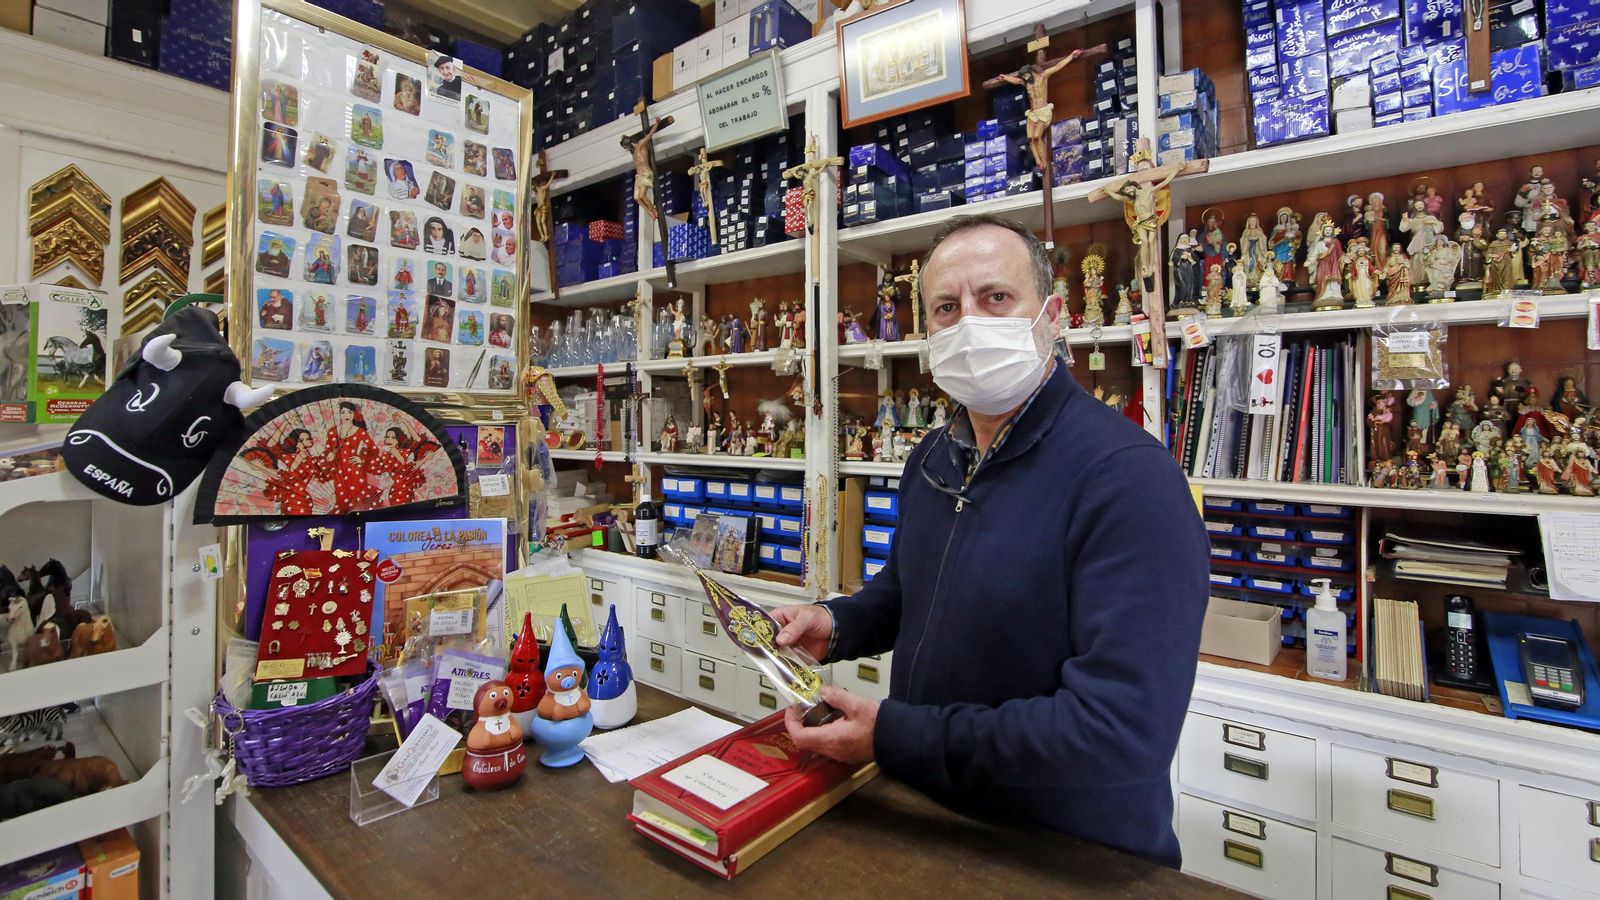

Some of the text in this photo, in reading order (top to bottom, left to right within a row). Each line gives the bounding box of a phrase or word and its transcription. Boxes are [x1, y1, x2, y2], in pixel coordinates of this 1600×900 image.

[714, 84, 734, 96] HACER
[736, 70, 769, 88] ENCARGOS
[708, 100, 738, 115] ABONARAN
[751, 91, 760, 99] 50
[730, 110, 758, 125] TRABAJO
[1257, 342, 1276, 359] YO
[83, 464, 134, 498] ESPAÑA
[388, 530, 431, 543] COLOREA
[443, 530, 455, 541] LA
[421, 538, 453, 551] Jerez
